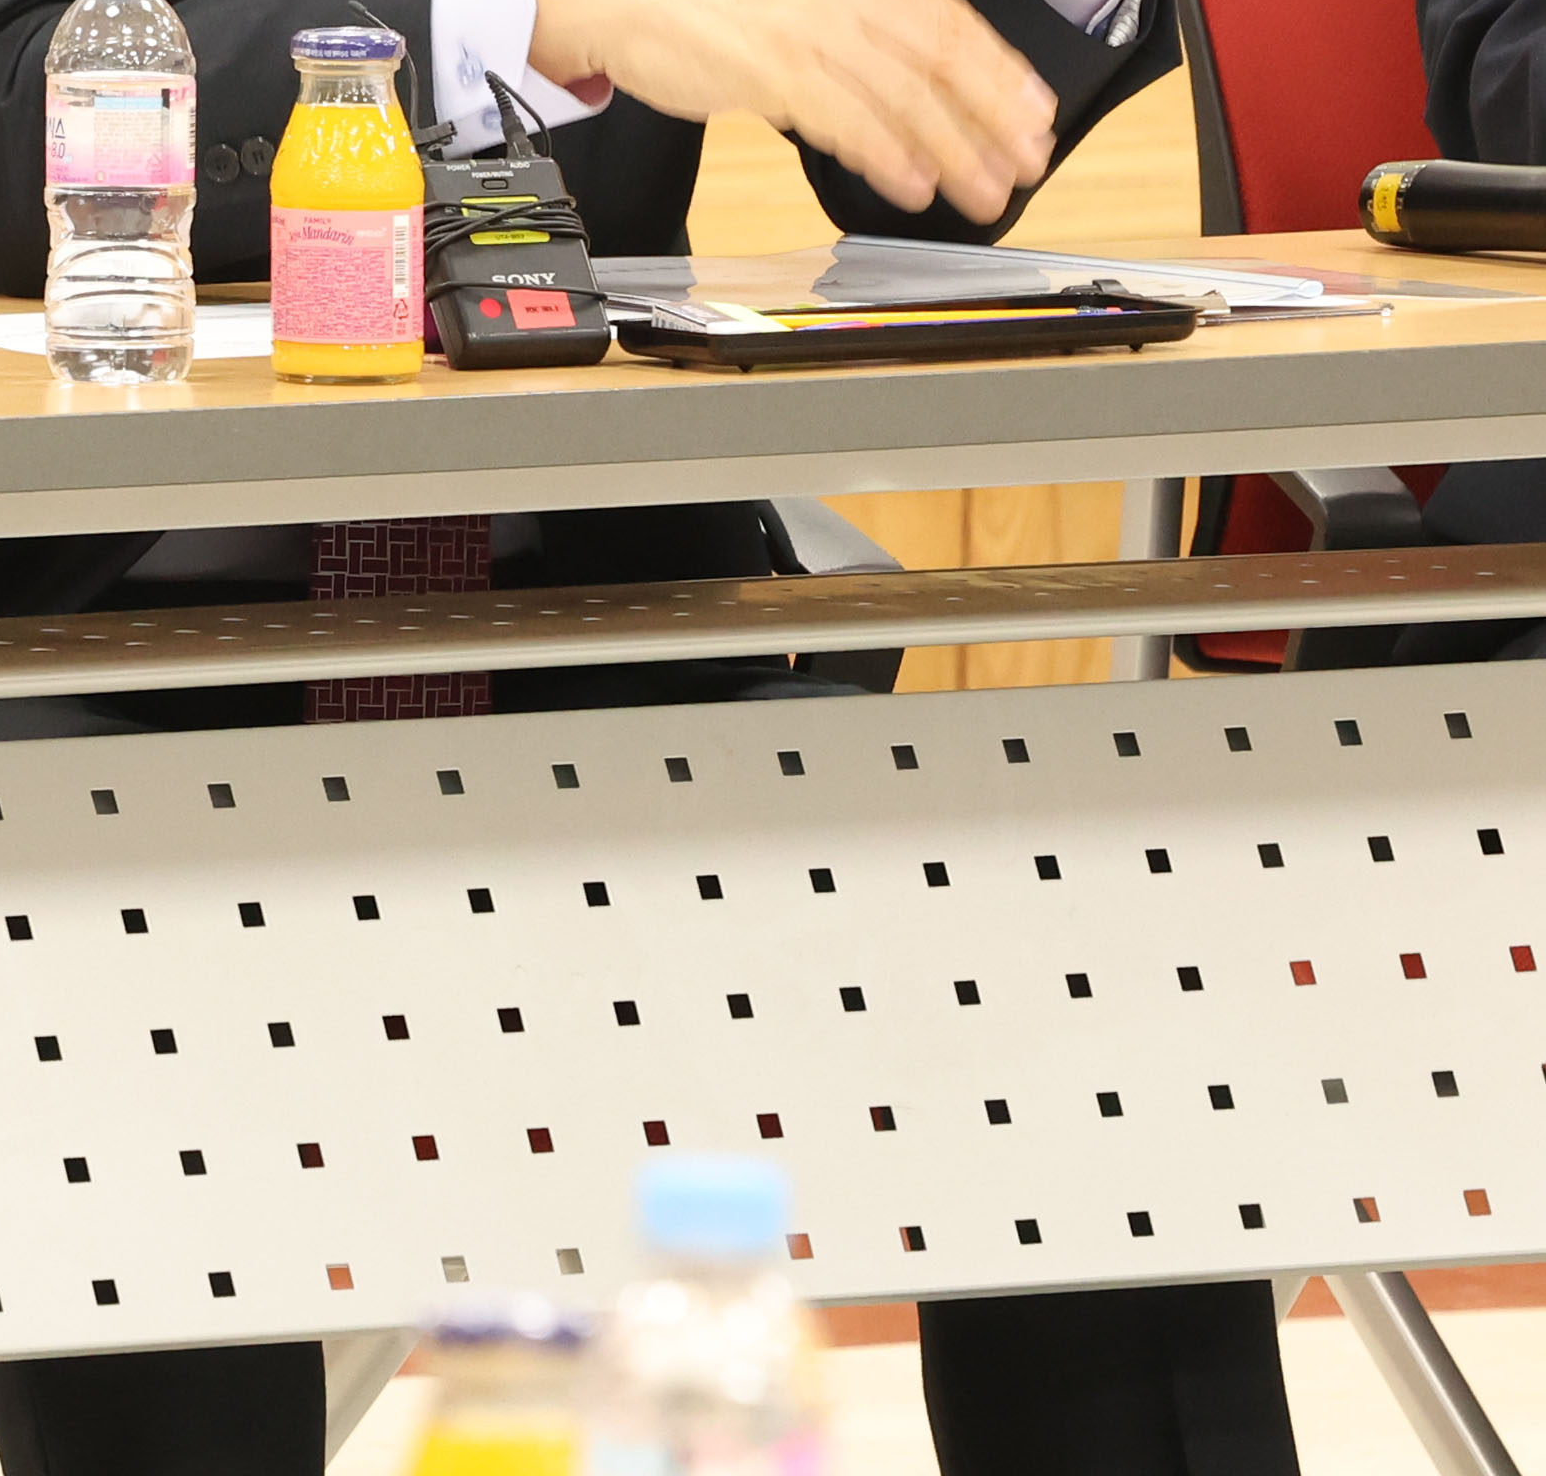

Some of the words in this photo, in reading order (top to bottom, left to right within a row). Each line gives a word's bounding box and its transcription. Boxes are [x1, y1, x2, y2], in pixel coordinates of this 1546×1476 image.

[446, 164, 471, 172] POWER
[302, 225, 354, 245] Mandarin
[491, 272, 556, 286] SONY
